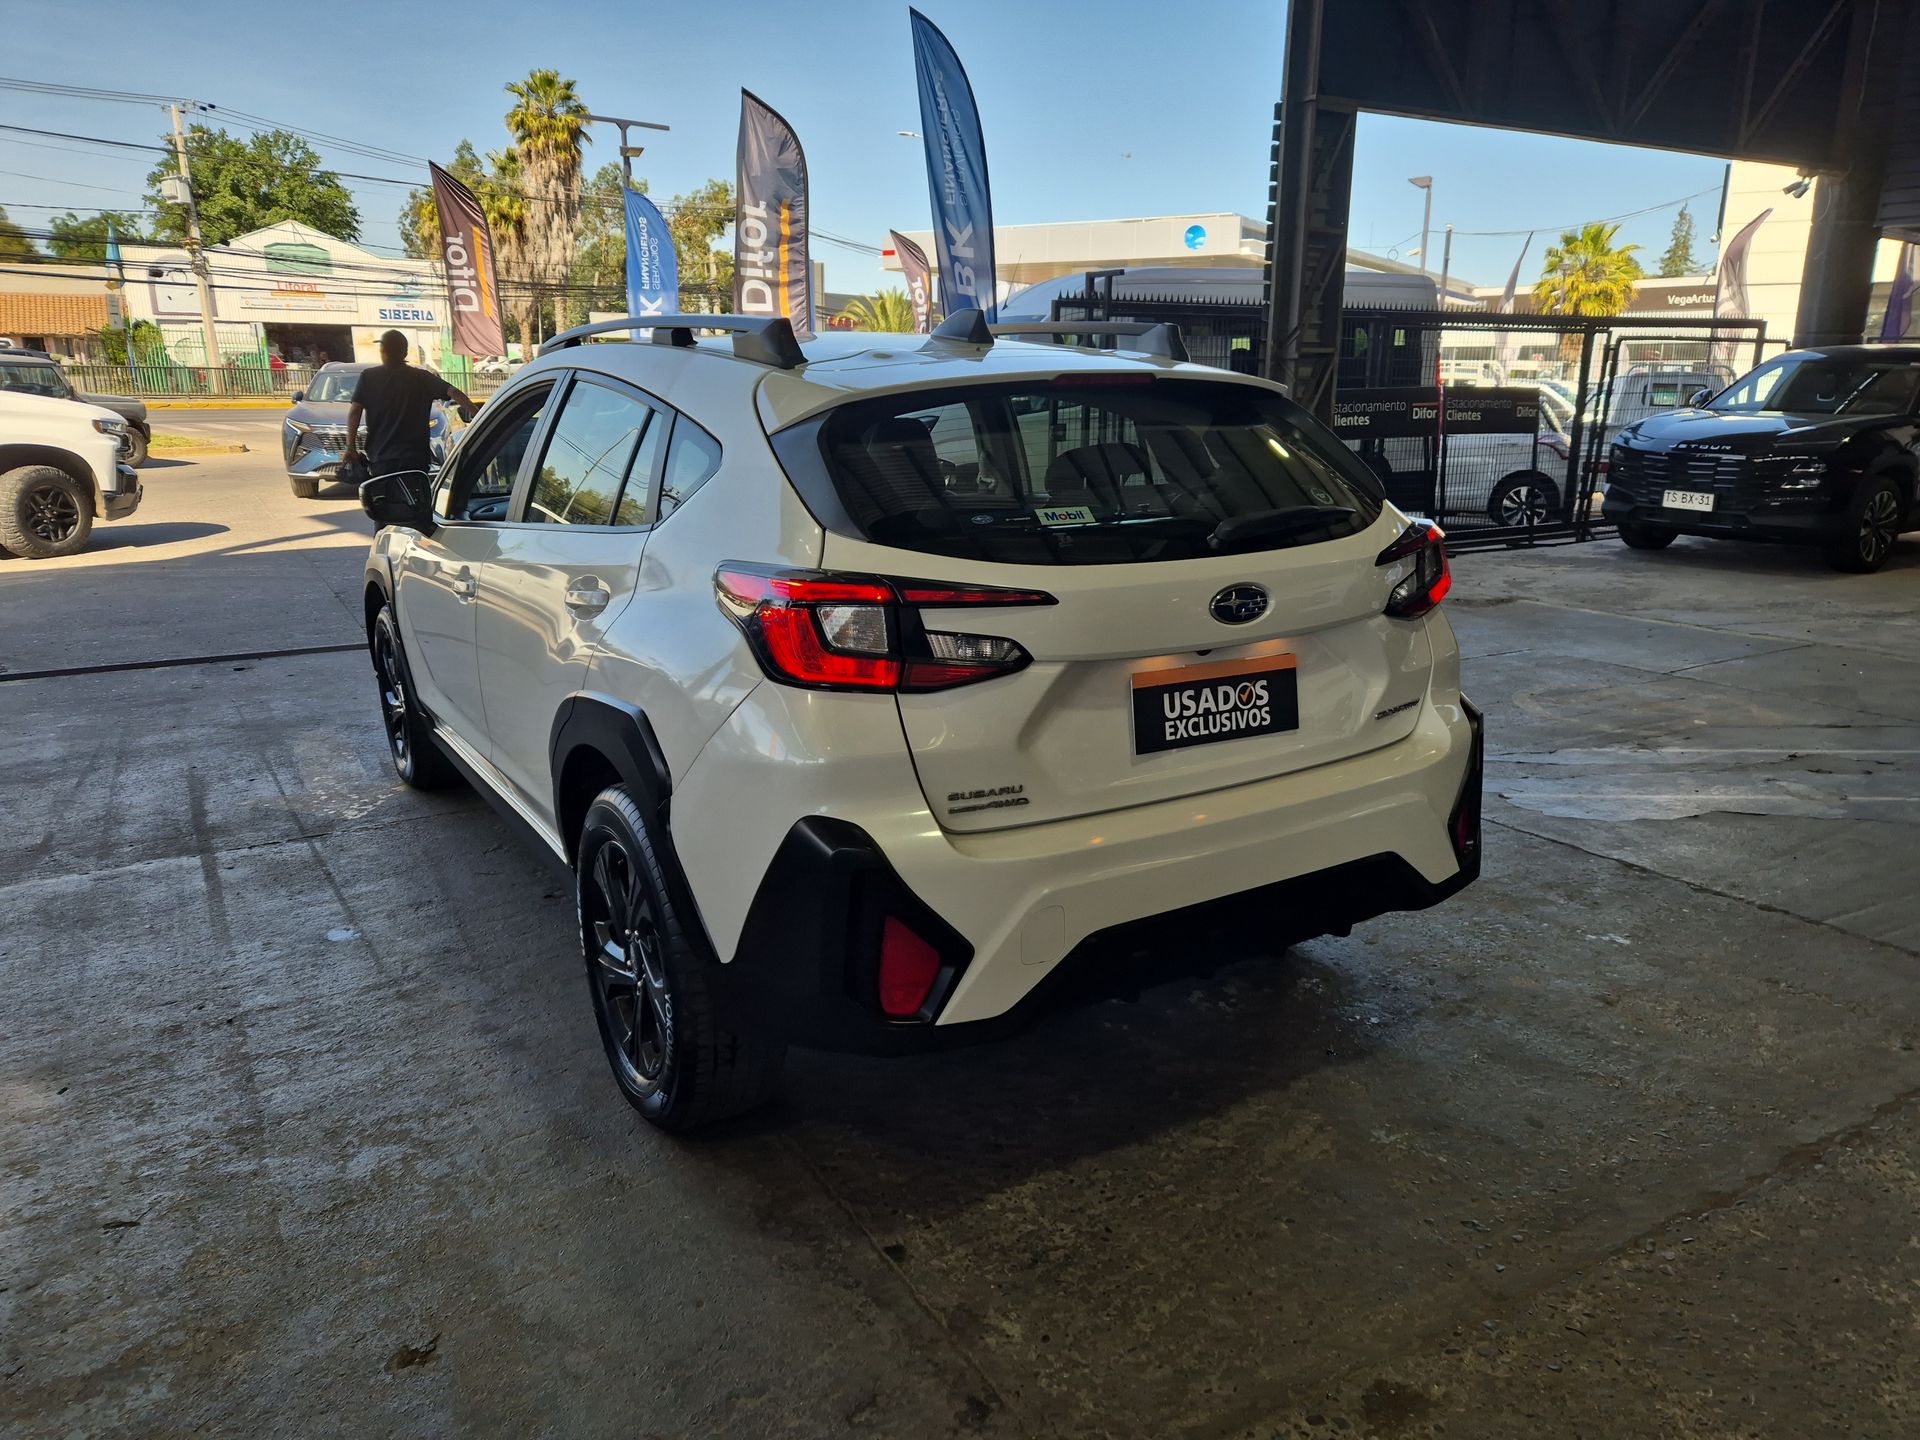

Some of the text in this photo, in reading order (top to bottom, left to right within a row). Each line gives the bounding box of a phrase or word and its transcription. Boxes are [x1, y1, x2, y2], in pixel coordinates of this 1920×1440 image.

[379, 308, 434, 321] SIBERIA
[1333, 401, 1406, 414] stacionamiento
[1447, 397, 1512, 409] Estacionamiento
[1412, 407, 1437, 419] Difor
[1446, 409, 1482, 421] Clientes
[1516, 406, 1538, 417] Difor
[1334, 414, 1370, 426] lientes
[1044, 510, 1085, 521] Mobil
[1163, 679, 1269, 720] USADOS
[1164, 706, 1271, 741] EXCLUSIVOS
[947, 784, 1024, 801] SUBARU
